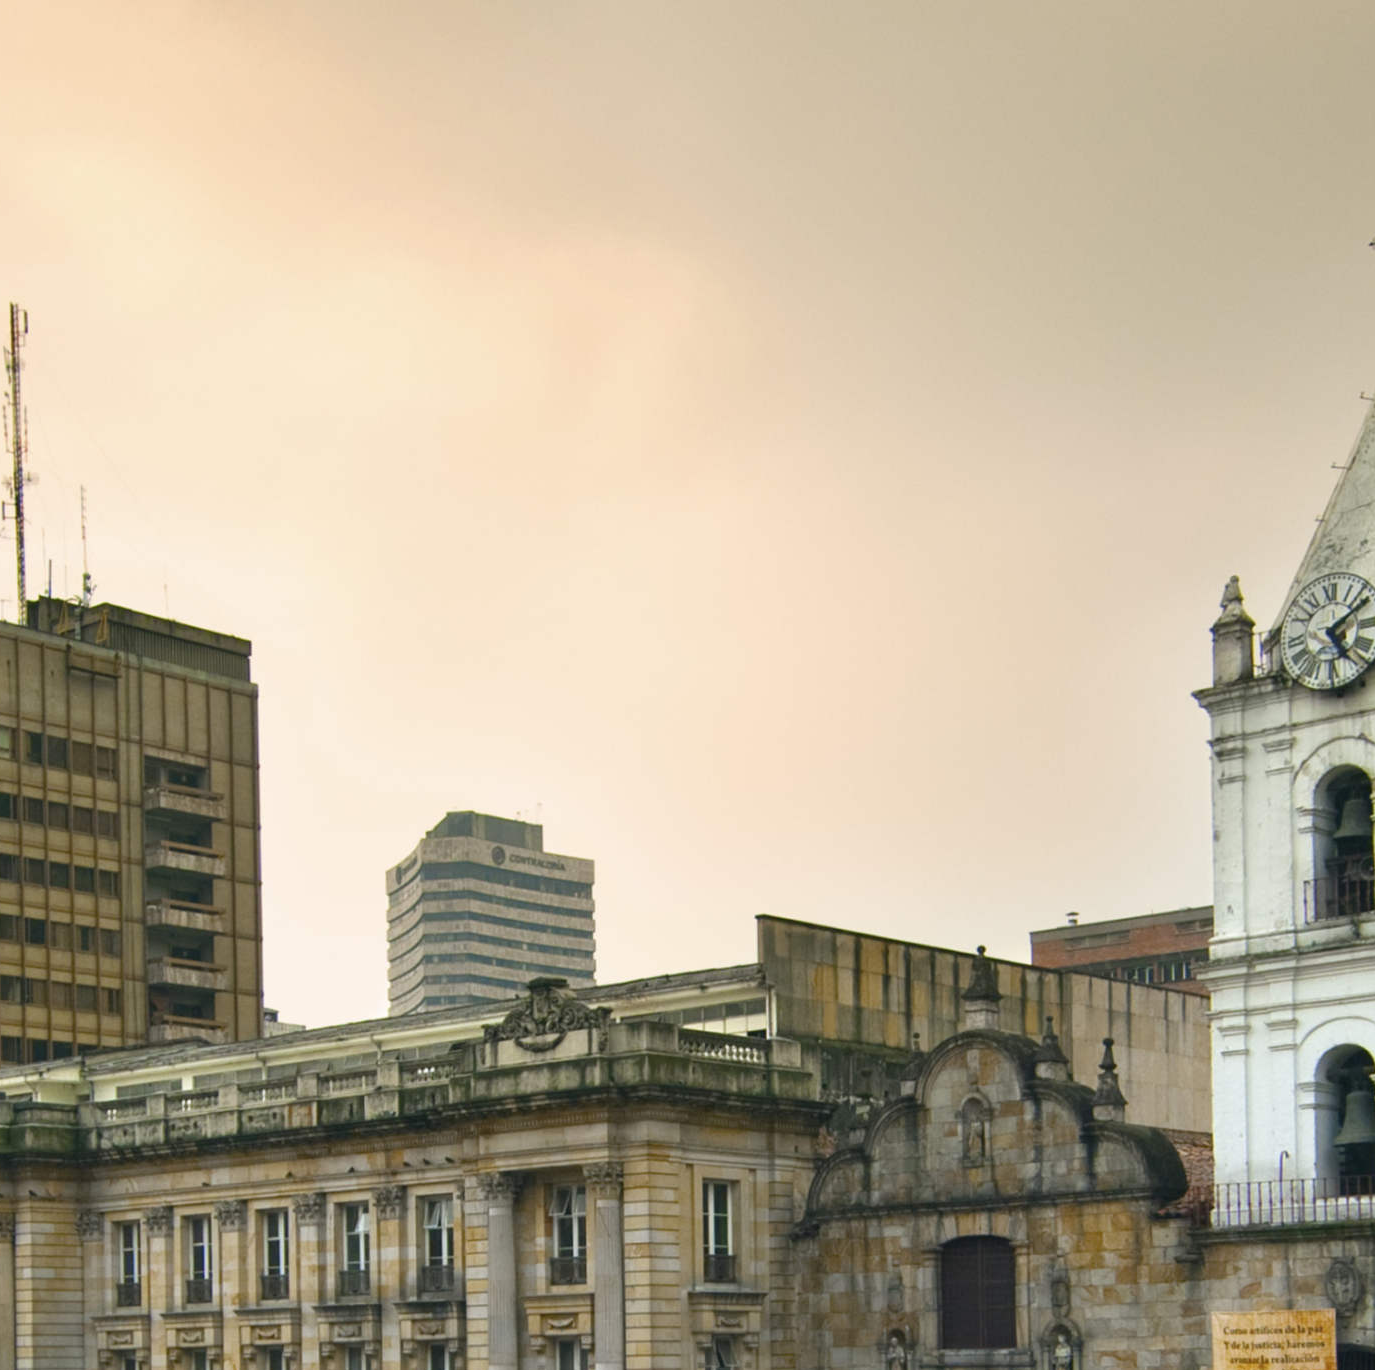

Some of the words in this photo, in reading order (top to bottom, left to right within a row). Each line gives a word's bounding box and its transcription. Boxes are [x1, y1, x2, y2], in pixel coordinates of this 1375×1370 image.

[1223, 1326, 1248, 1335] Como
[1285, 1325, 1296, 1334] de
[1297, 1325, 1306, 1333] la
[1307, 1325, 1324, 1335] paz
[1223, 1340, 1231, 1350] Y
[1230, 1340, 1240, 1350] de
[1242, 1341, 1250, 1349] la
[1286, 1339, 1326, 1349] haremos
